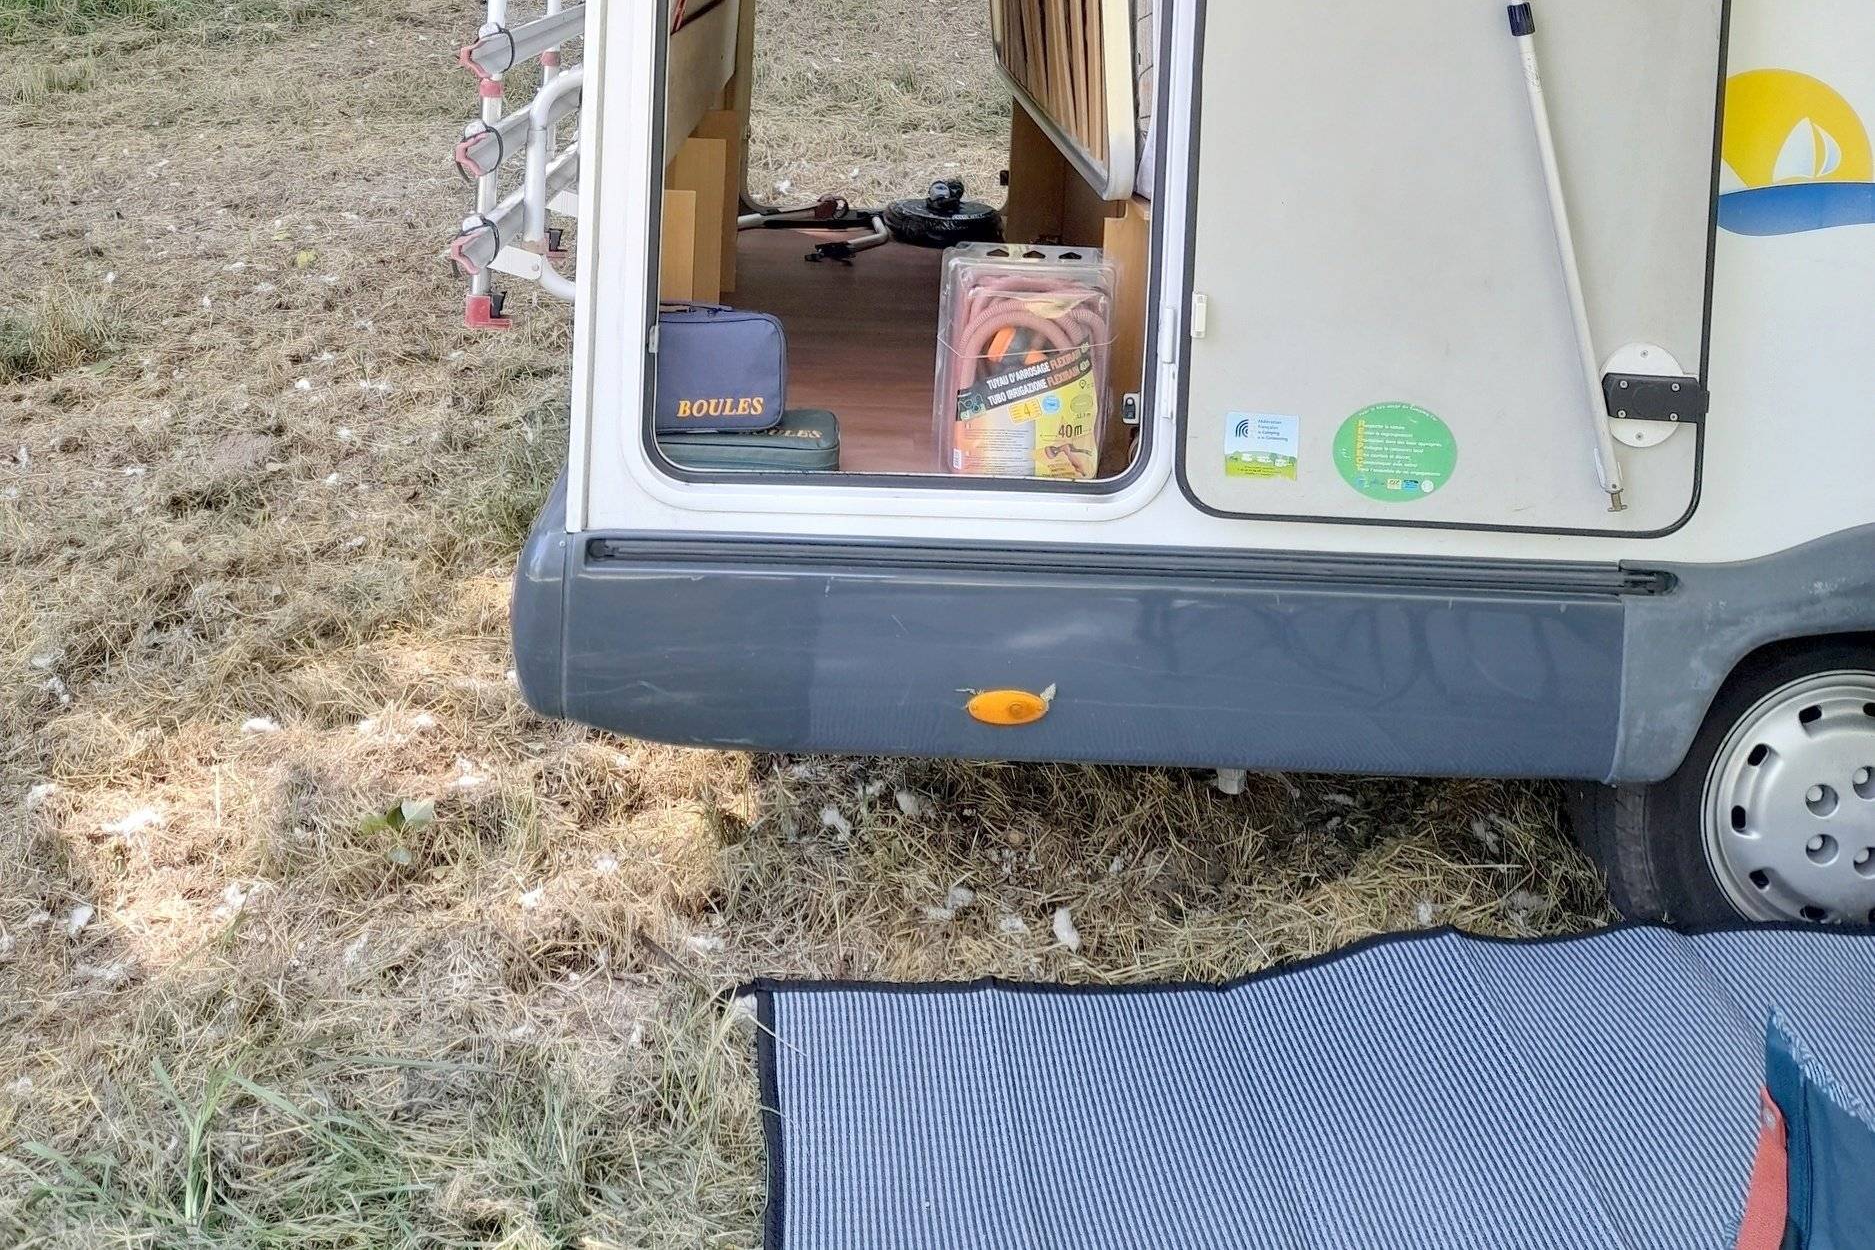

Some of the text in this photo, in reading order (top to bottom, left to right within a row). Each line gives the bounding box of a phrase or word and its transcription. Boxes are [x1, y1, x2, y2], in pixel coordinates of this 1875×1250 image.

[986, 375, 1009, 391] TUYAU
[1008, 361, 1051, 384] D'ARROSAGE
[987, 392, 1007, 406] TUBO
[1007, 378, 1049, 400] IRRIGAZIONE
[677, 396, 764, 417] BOULES
[1058, 423, 1074, 439] 40
